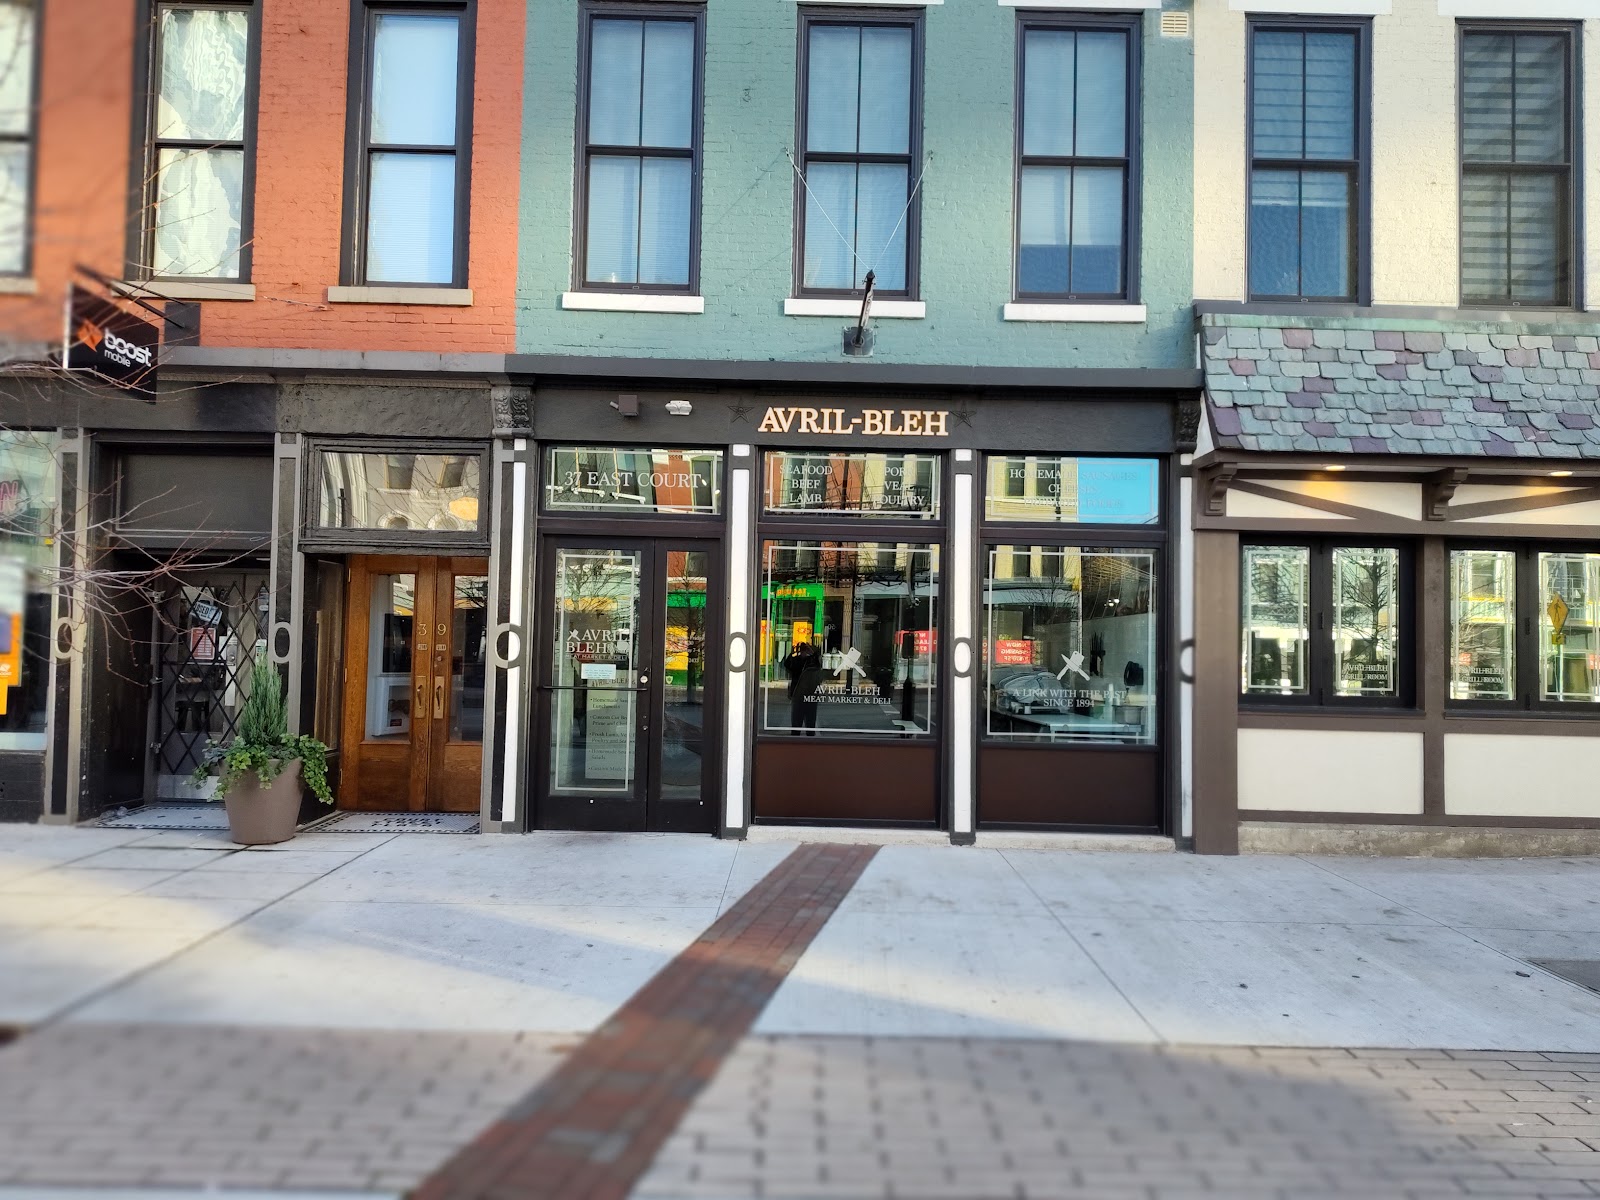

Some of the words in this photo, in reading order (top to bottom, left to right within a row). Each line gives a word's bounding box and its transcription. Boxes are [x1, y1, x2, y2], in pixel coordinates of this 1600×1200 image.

[104, 327, 152, 367] boost
[104, 350, 131, 368] mobile
[757, 406, 949, 436] AVRIL-BLEH
[779, 464, 833, 475] SEAFOOD
[564, 471, 582, 486] 37
[587, 471, 633, 487] EAST
[637, 473, 702, 488] COURT
[791, 479, 821, 489] BEEF
[789, 493, 823, 504] LAMB
[872, 495, 926, 505] POULTRY
[565, 641, 609, 654] BLEH
[814, 685, 881, 696] AVRIL-BLEH
[1012, 688, 1020, 697] A
[1021, 689, 1048, 698] LINK
[1049, 689, 1077, 698] WITH
[1079, 689, 1100, 698] THE
[1103, 690, 1127, 699] PAST
[803, 695, 827, 703] MEAT
[827, 696, 863, 704] MARKET
[864, 696, 871, 704] &
[873, 697, 892, 705] DELI
[1043, 698, 1074, 707] SINCE
[1075, 698, 1095, 708] 1894
